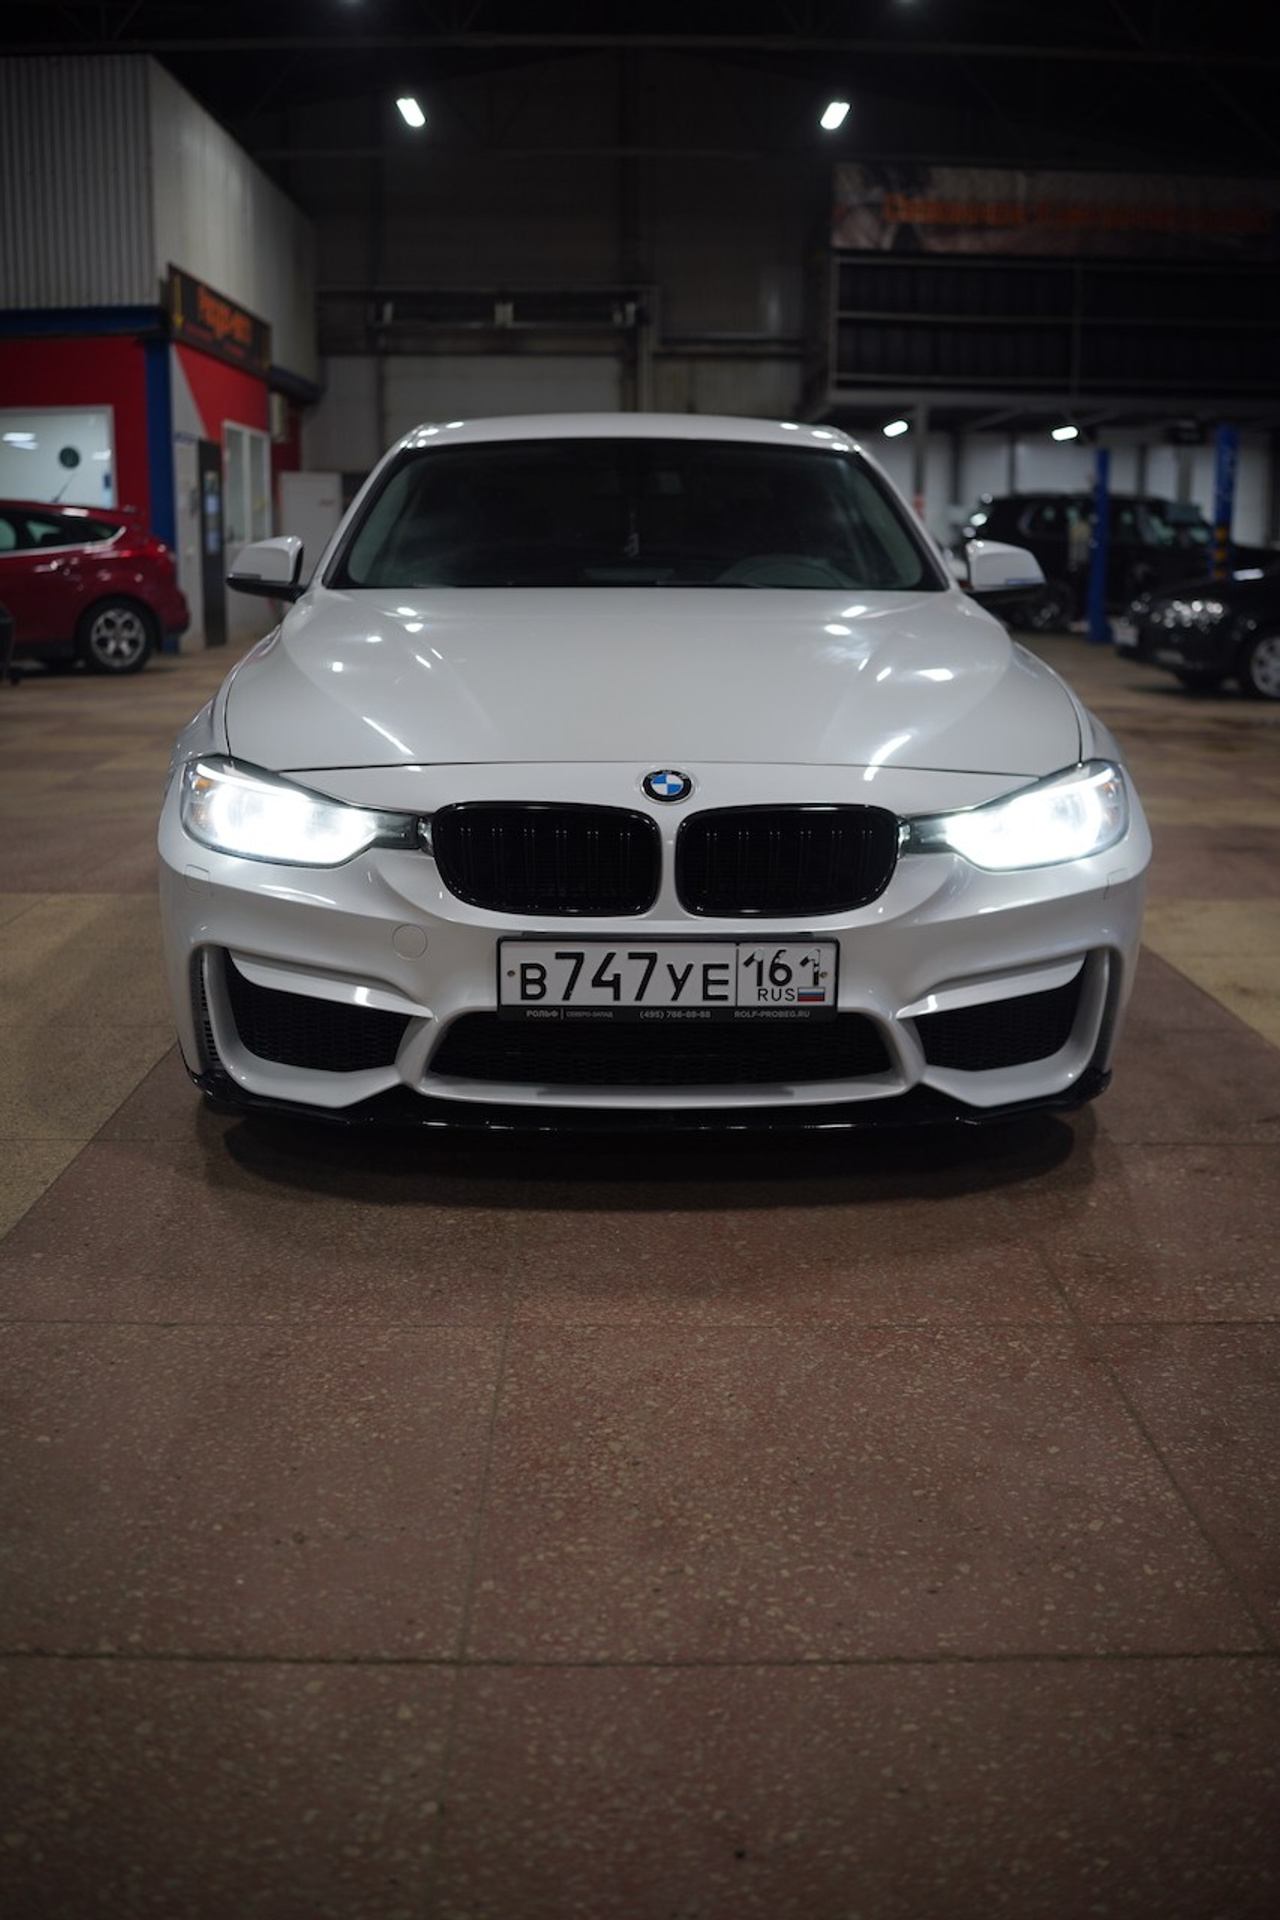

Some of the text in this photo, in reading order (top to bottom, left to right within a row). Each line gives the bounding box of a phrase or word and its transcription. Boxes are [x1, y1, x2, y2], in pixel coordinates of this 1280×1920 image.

[743, 947, 820, 986] 161
[519, 951, 730, 1002] В747УЕ
[757, 988, 796, 1002] RUS
[526, 1010, 559, 1018] РОЛЬФ
[640, 1010, 664, 1019] (495)
